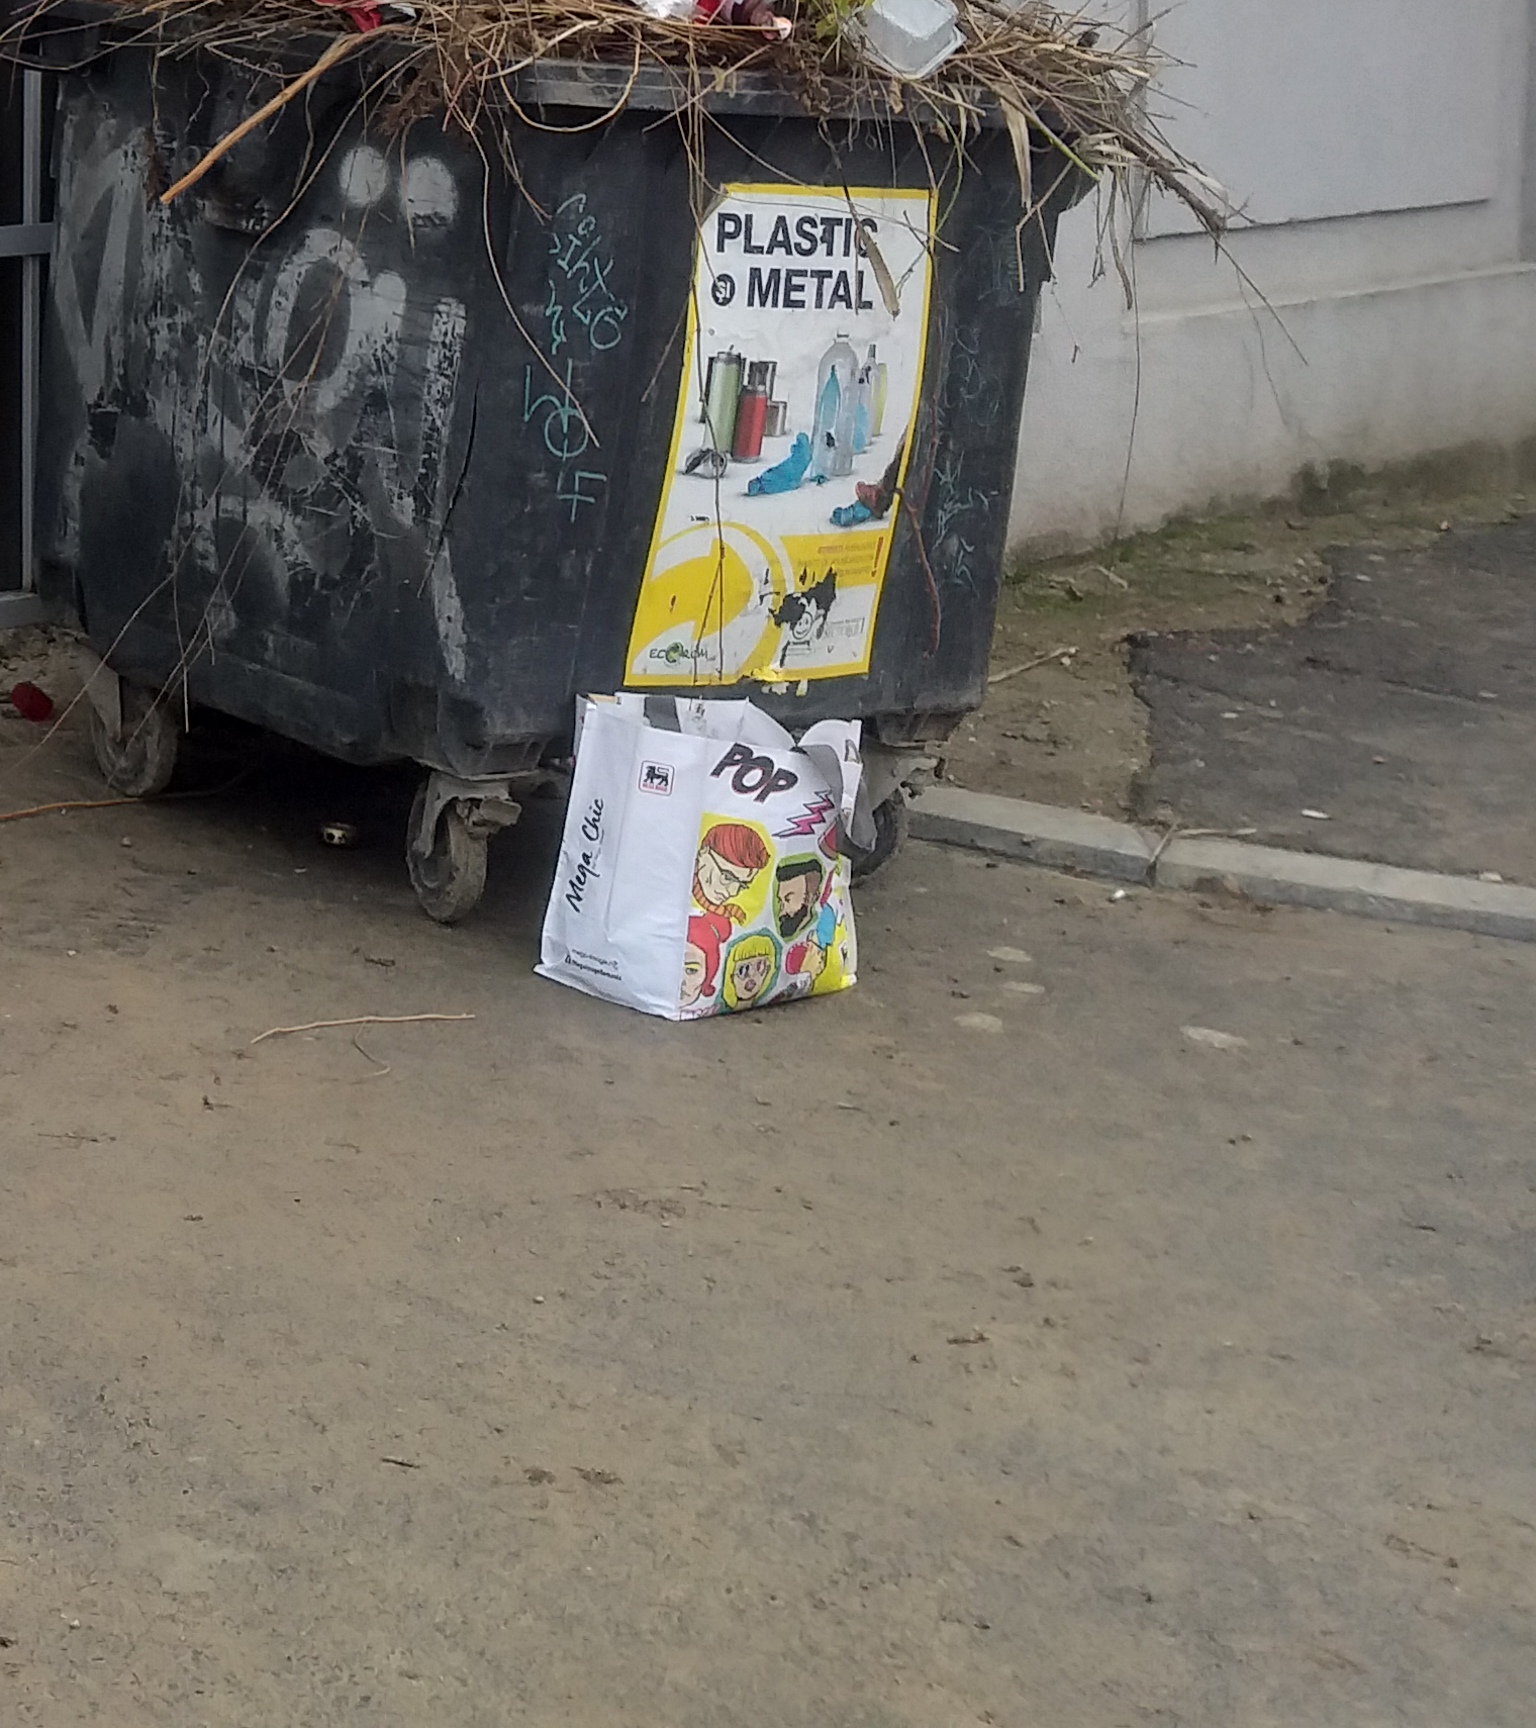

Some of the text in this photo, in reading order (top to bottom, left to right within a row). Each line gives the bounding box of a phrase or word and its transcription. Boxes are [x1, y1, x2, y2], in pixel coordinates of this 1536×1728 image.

[746, 266, 875, 311] METAL
[709, 741, 799, 804] POP
[581, 798, 604, 842] Chic
[565, 851, 601, 913] Mega
